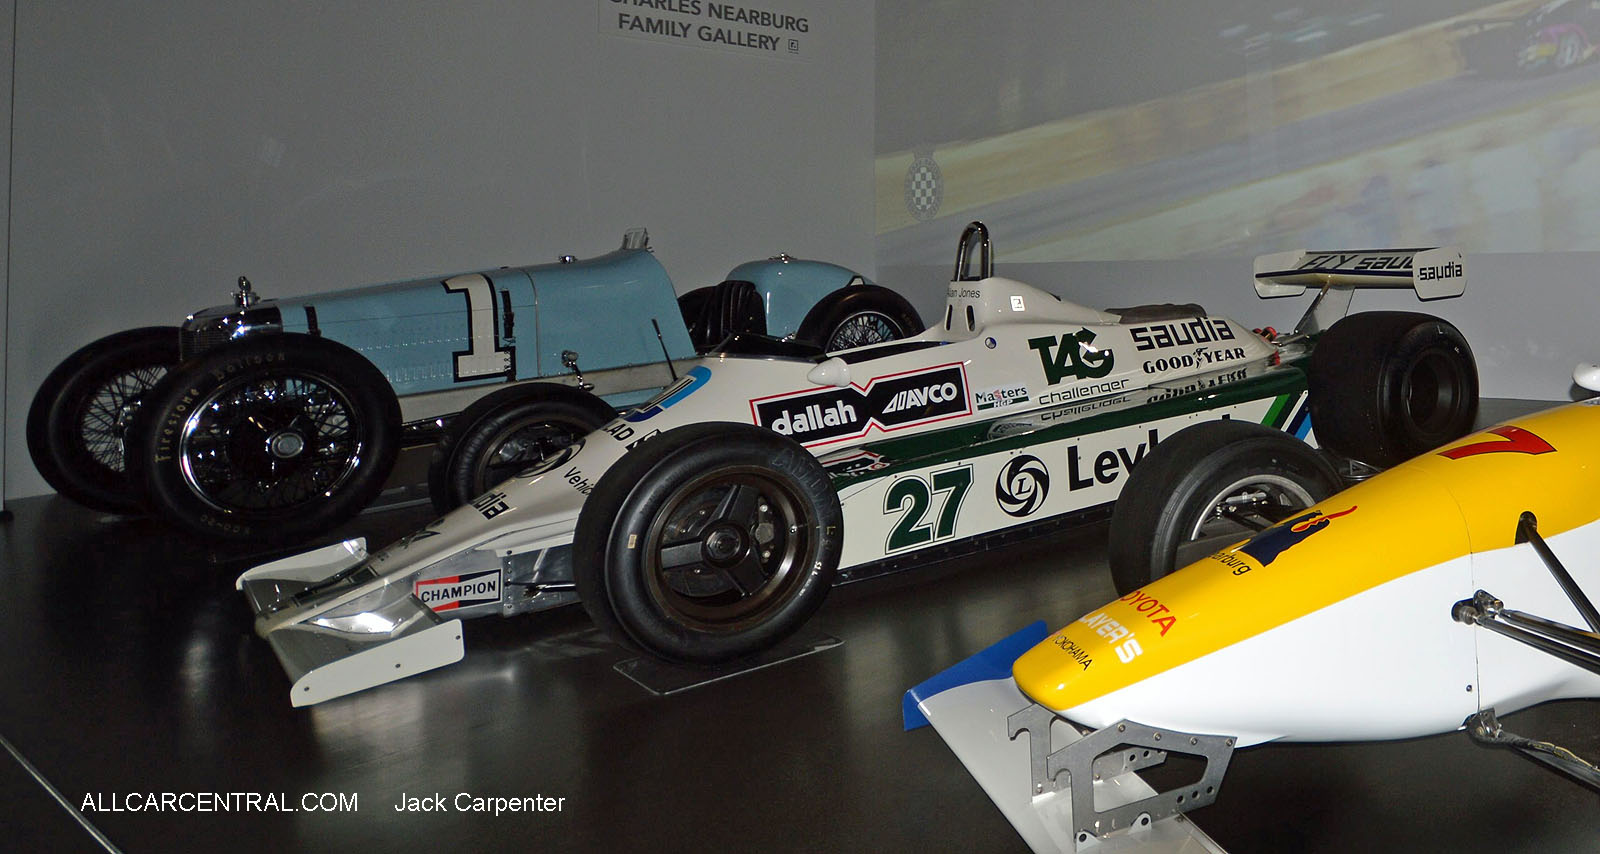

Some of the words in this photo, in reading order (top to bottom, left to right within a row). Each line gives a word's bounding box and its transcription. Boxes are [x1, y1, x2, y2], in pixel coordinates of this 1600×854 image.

[610, 0, 701, 15] ARLES
[707, 3, 809, 33] NEARBURG
[618, 13, 692, 38] FAMILY
[697, 26, 780, 51] GALLERY
[1299, 254, 1359, 270] FLY
[1419, 261, 1463, 281] saudia
[958, 288, 981, 299] Jones
[441, 273, 516, 383] 1
[1129, 316, 1236, 351] saudia
[1028, 327, 1114, 386] TAG
[975, 386, 1028, 404] Masters
[1039, 378, 1130, 406] challenger
[604, 423, 635, 442] AD
[771, 399, 858, 436] dallah
[1436, 425, 1558, 461] 7
[883, 464, 974, 555] 27
[1206, 551, 1251, 577] arburg
[421, 580, 497, 603] CHAMPION
